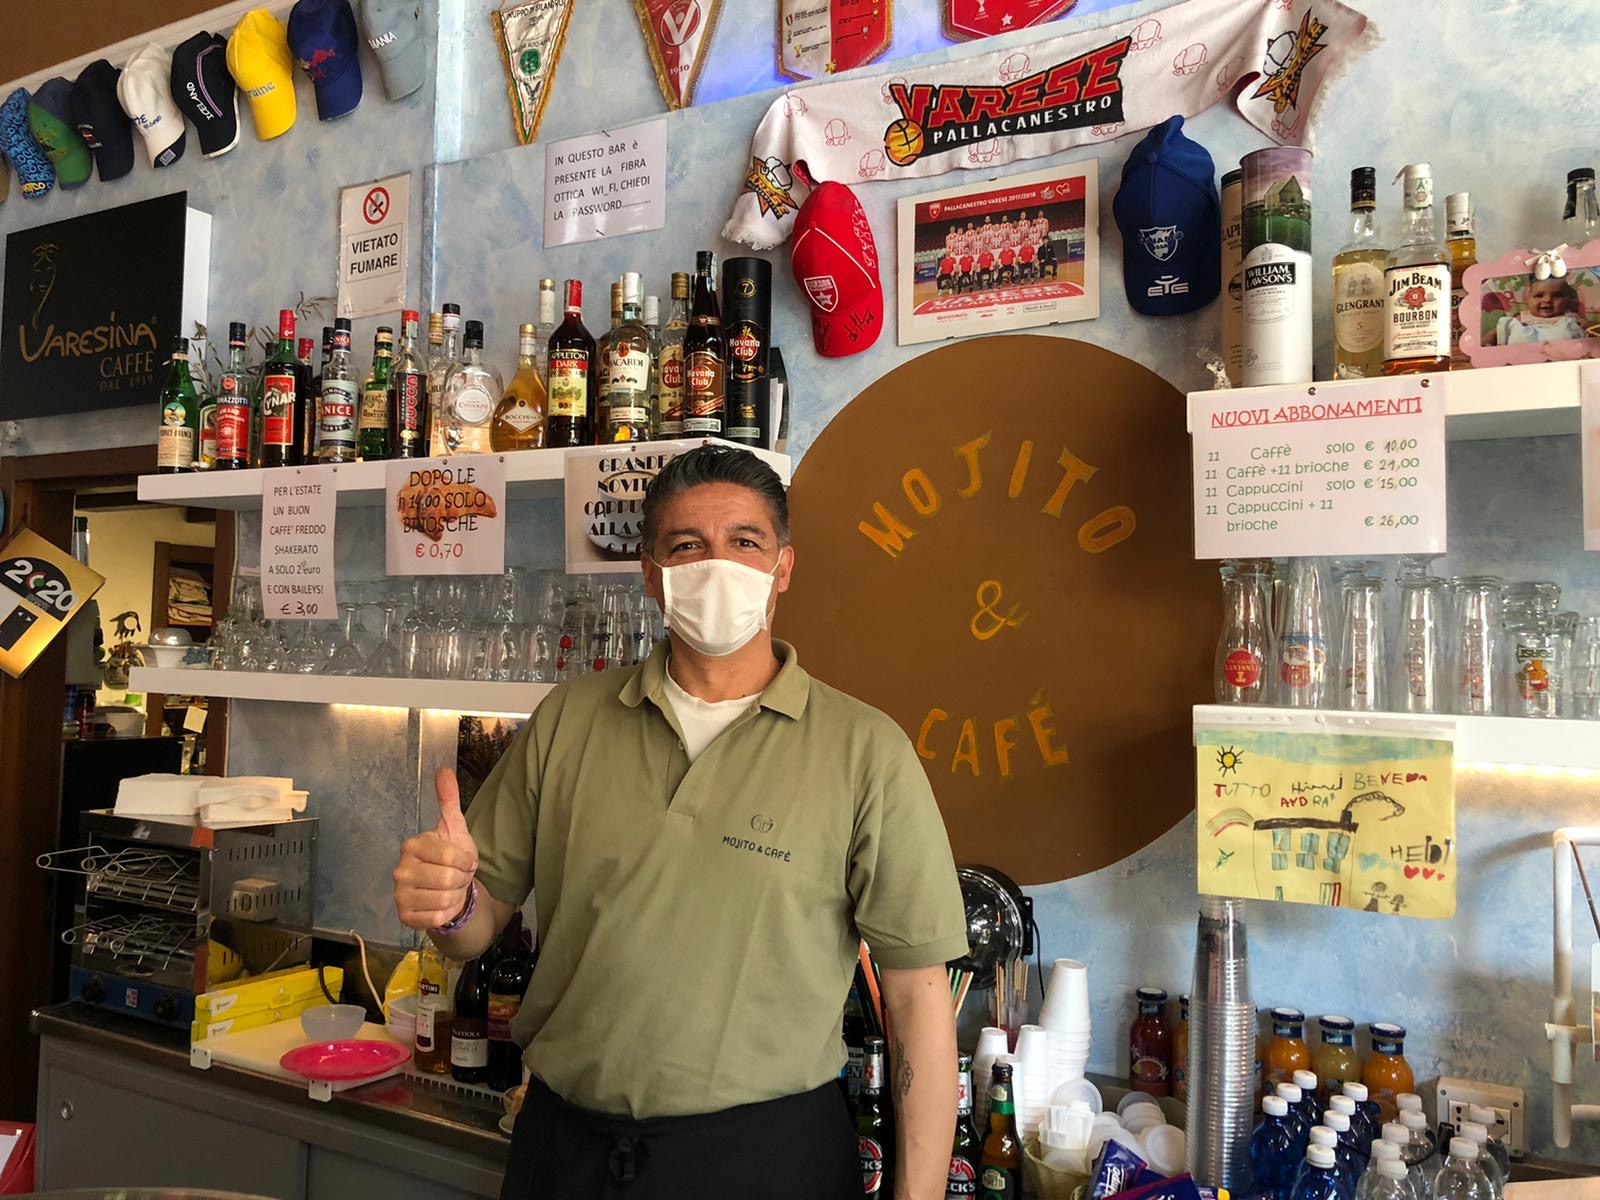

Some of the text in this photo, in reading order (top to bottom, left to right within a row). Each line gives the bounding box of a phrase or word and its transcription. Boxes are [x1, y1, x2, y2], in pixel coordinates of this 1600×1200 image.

[369, 31, 398, 50] MANIA
[889, 36, 1132, 128] VARESE
[186, 81, 215, 121] ICELAND
[933, 95, 1112, 144] PALLACANESTRO
[554, 156, 564, 166] IN
[568, 147, 604, 163] QUESTO
[608, 142, 626, 155] BAR
[554, 158, 647, 185] PRESENTE LA FIBRA
[553, 189, 584, 203] OTTICA
[620, 176, 651, 190] CHIEDI
[944, 200, 987, 212] PALLACANESTRO
[987, 196, 1008, 206] VARESE
[553, 211, 564, 221] LA
[352, 232, 398, 254] VIETATO
[350, 254, 398, 275] FUMARE
[1247, 264, 1290, 278] WILLIAM
[1246, 273, 1293, 289] LAWSON'S
[1389, 272, 1442, 296] JIM BEAM
[1393, 310, 1438, 323] BOURBON
[730, 337, 760, 349] Havana
[734, 346, 754, 357] Club
[551, 352, 586, 360] APPLETON
[556, 360, 579, 368] DARK
[664, 365, 683, 374] avan
[687, 369, 715, 378] Havana
[691, 377, 709, 386] Club
[217, 396, 248, 405] MAZZOTTI
[263, 388, 296, 416] CYNAR
[405, 374, 418, 430] ZUCCA
[1211, 397, 1423, 428] NUOVI ABBONAMENTI
[1250, 444, 1291, 460] Caffè
[1326, 442, 1355, 454] solo
[1365, 441, 1375, 452] €
[599, 455, 667, 473] GRANDE
[1226, 463, 1266, 479] Caffè
[1295, 460, 1350, 474] brioche
[1363, 459, 1374, 471] €
[410, 468, 476, 487] DOPO LE
[598, 478, 648, 494] NOVIT
[273, 484, 322, 497] PER L'ESTATE
[858, 431, 1136, 558] MOJITO
[1226, 481, 1303, 498] Cappuccini
[1326, 479, 1355, 491] solo
[1364, 478, 1374, 490] €
[444, 491, 487, 509] SOLO
[1226, 498, 1303, 516] Cappuccini
[273, 505, 310, 516] UN BUON
[584, 501, 646, 519] CAPPU
[295, 524, 326, 535] FREDDO
[589, 521, 632, 536] ALLA
[1227, 514, 1419, 532] brioche € 26,00
[274, 544, 319, 555] SHAKERATO
[415, 543, 464, 559] € 0,70
[268, 565, 274, 574] A
[275, 564, 295, 575] SOLO
[302, 565, 321, 575] euro
[267, 584, 324, 595] E CON BAILEYS!
[280, 601, 319, 617] € 3,00
[971, 580, 1030, 641] &
[917, 688, 1069, 781] CAFÉ
[1213, 783, 1271, 798] TUTTO
[1353, 772, 1404, 791] BENE
[722, 835, 756, 851] MOJITO
[948, 1182, 976, 1193] CK'S
